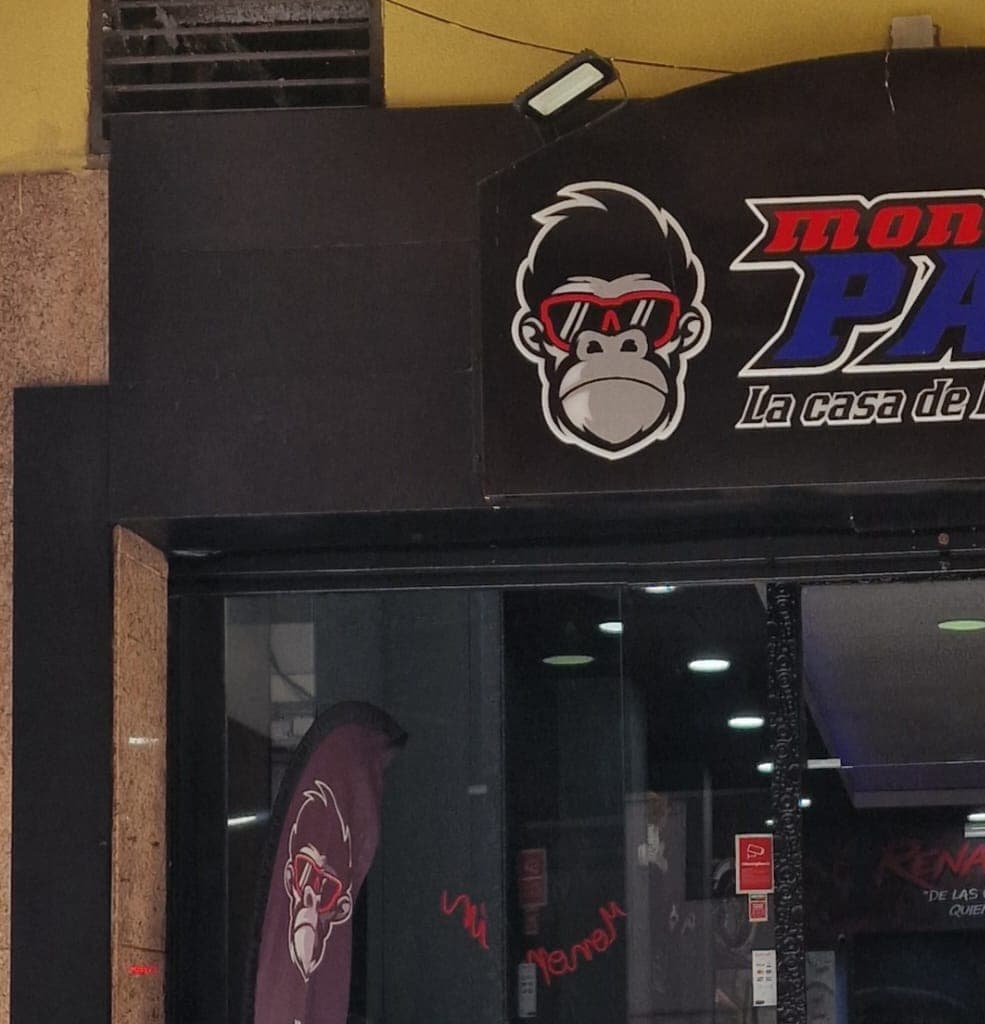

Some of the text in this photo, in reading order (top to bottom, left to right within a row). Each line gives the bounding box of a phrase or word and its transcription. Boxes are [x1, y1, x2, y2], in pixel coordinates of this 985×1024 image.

[736, 383, 794, 430] La
[801, 385, 907, 427] casa
[914, 378, 968, 424] de
[952, 887, 978, 901] LAS
